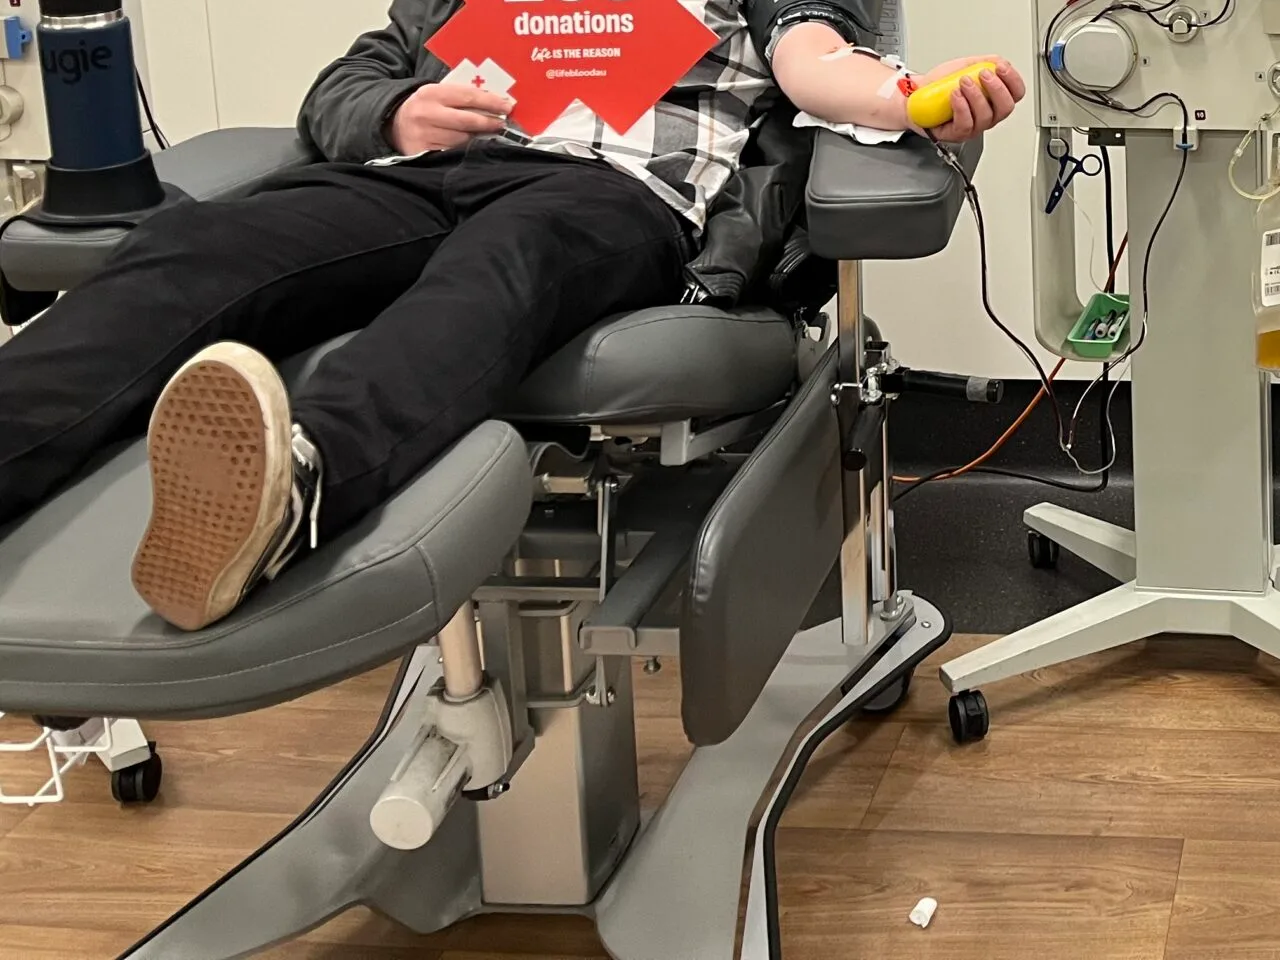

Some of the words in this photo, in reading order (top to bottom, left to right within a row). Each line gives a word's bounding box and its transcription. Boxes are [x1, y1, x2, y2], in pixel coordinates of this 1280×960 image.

[514, 11, 634, 35] donations
[531, 46, 552, 62] life
[552, 48, 563, 59] IS
[563, 48, 581, 58] THE
[582, 47, 621, 58] REASON
